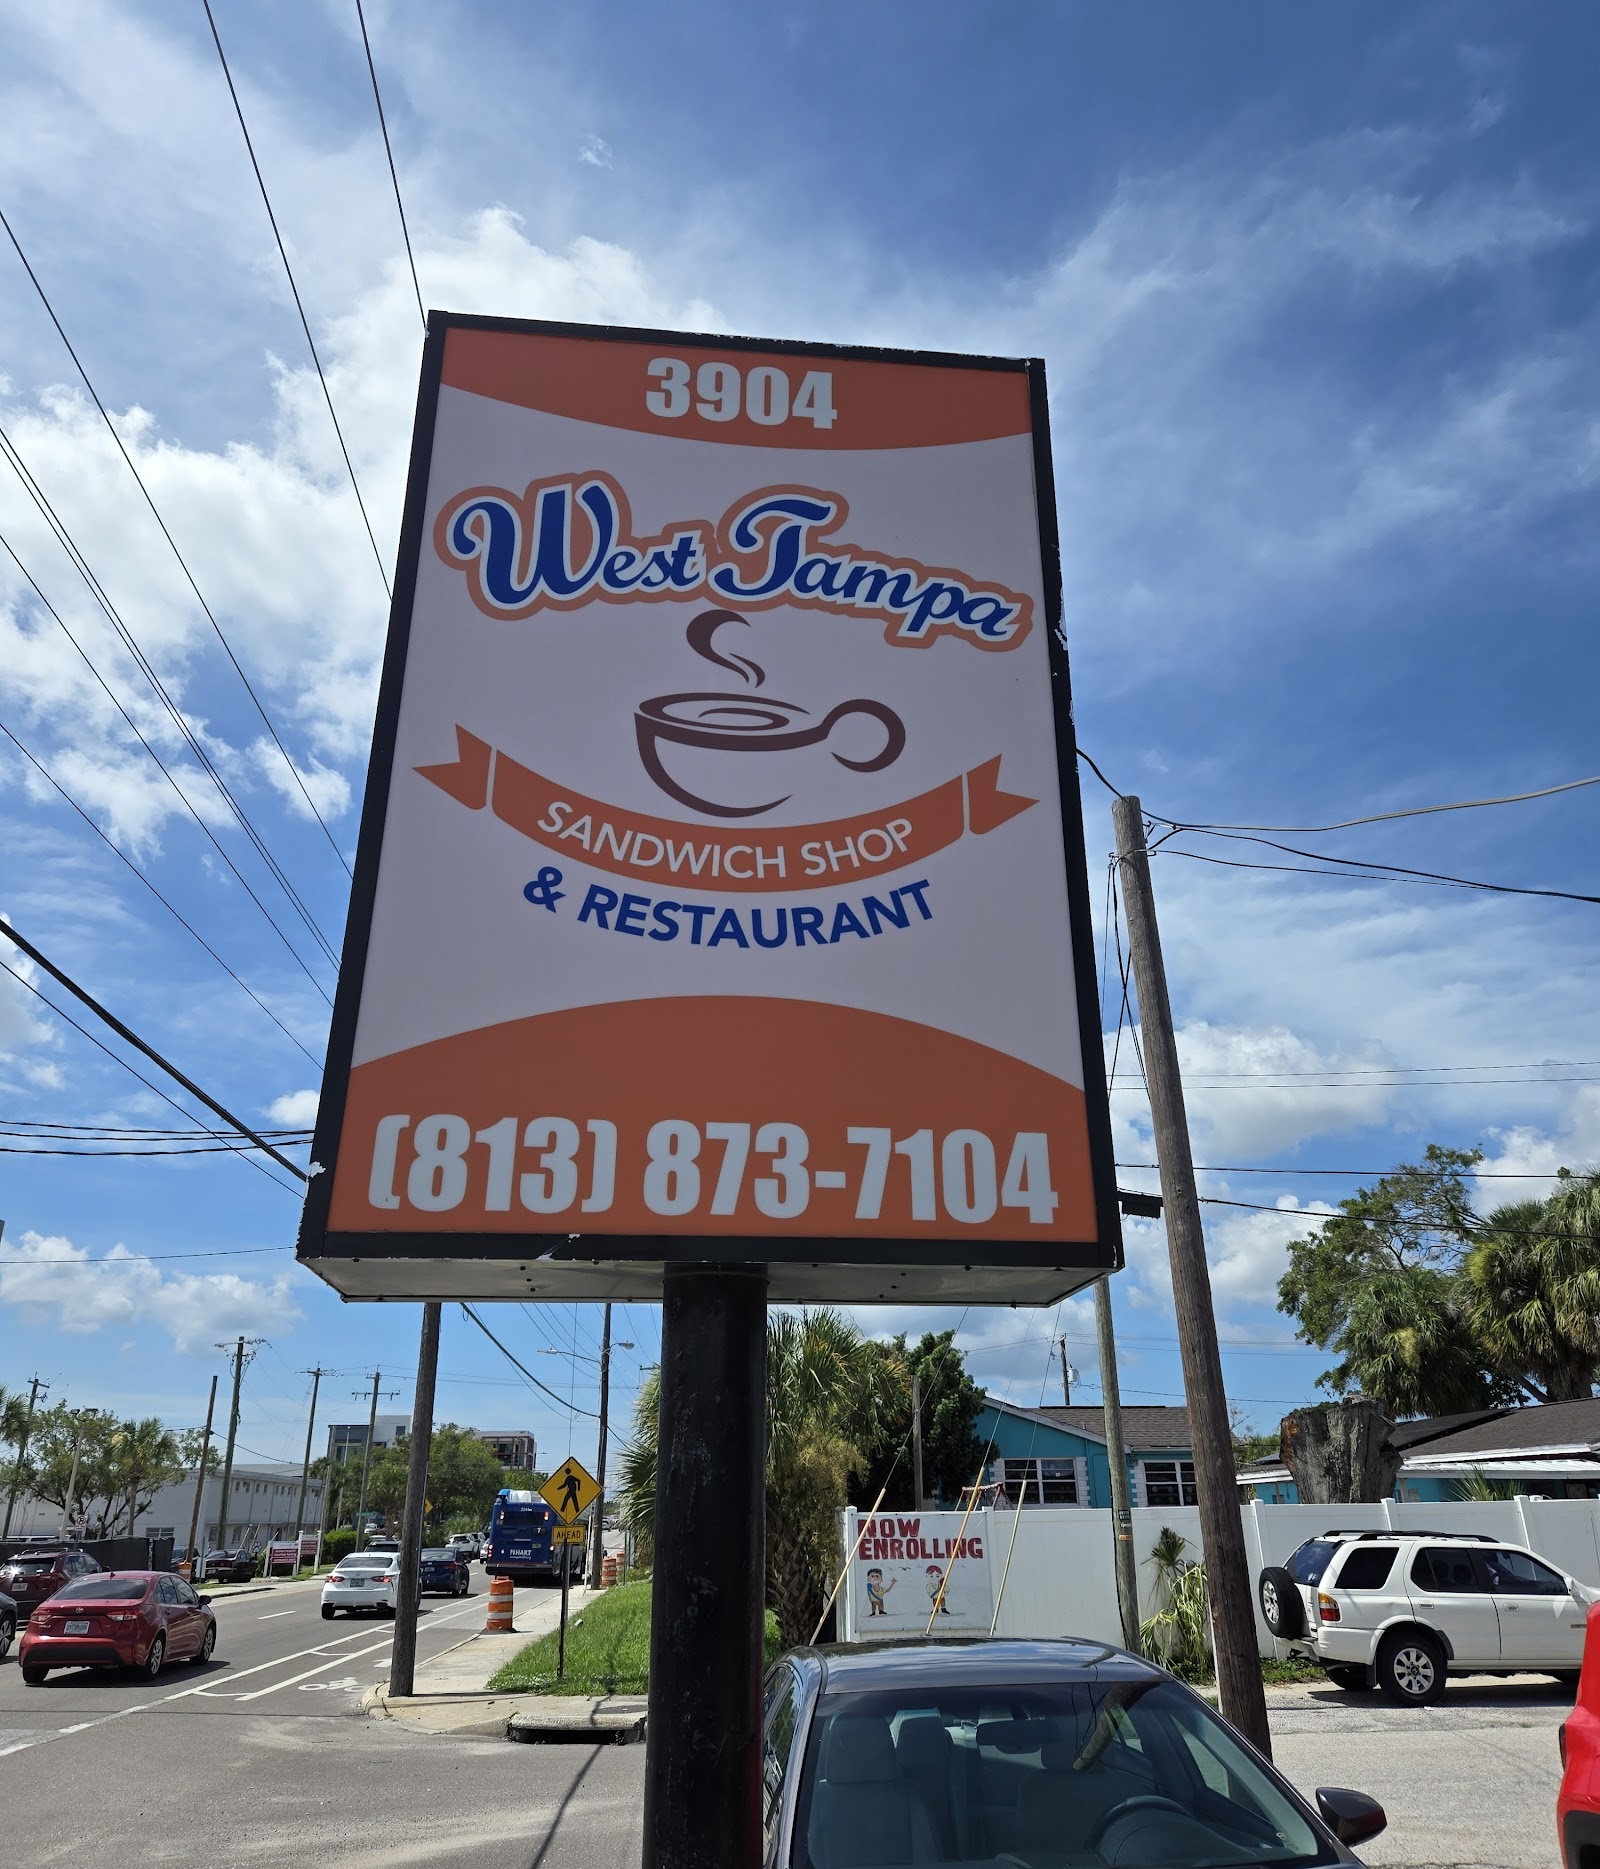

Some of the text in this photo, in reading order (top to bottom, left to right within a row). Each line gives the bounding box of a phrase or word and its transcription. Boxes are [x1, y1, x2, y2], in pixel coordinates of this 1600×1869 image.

[645, 356, 839, 430] 3904
[452, 483, 1018, 637] West Tampa
[536, 801, 913, 880] SANDWICH SHOP
[523, 868, 933, 949] & RESTAURANT
[368, 1113, 1060, 1225] (813) 873-7104
[556, 1530, 581, 1539] AHEAD
[857, 1518, 920, 1538] NOW
[858, 1537, 983, 1560] ENROLLING
